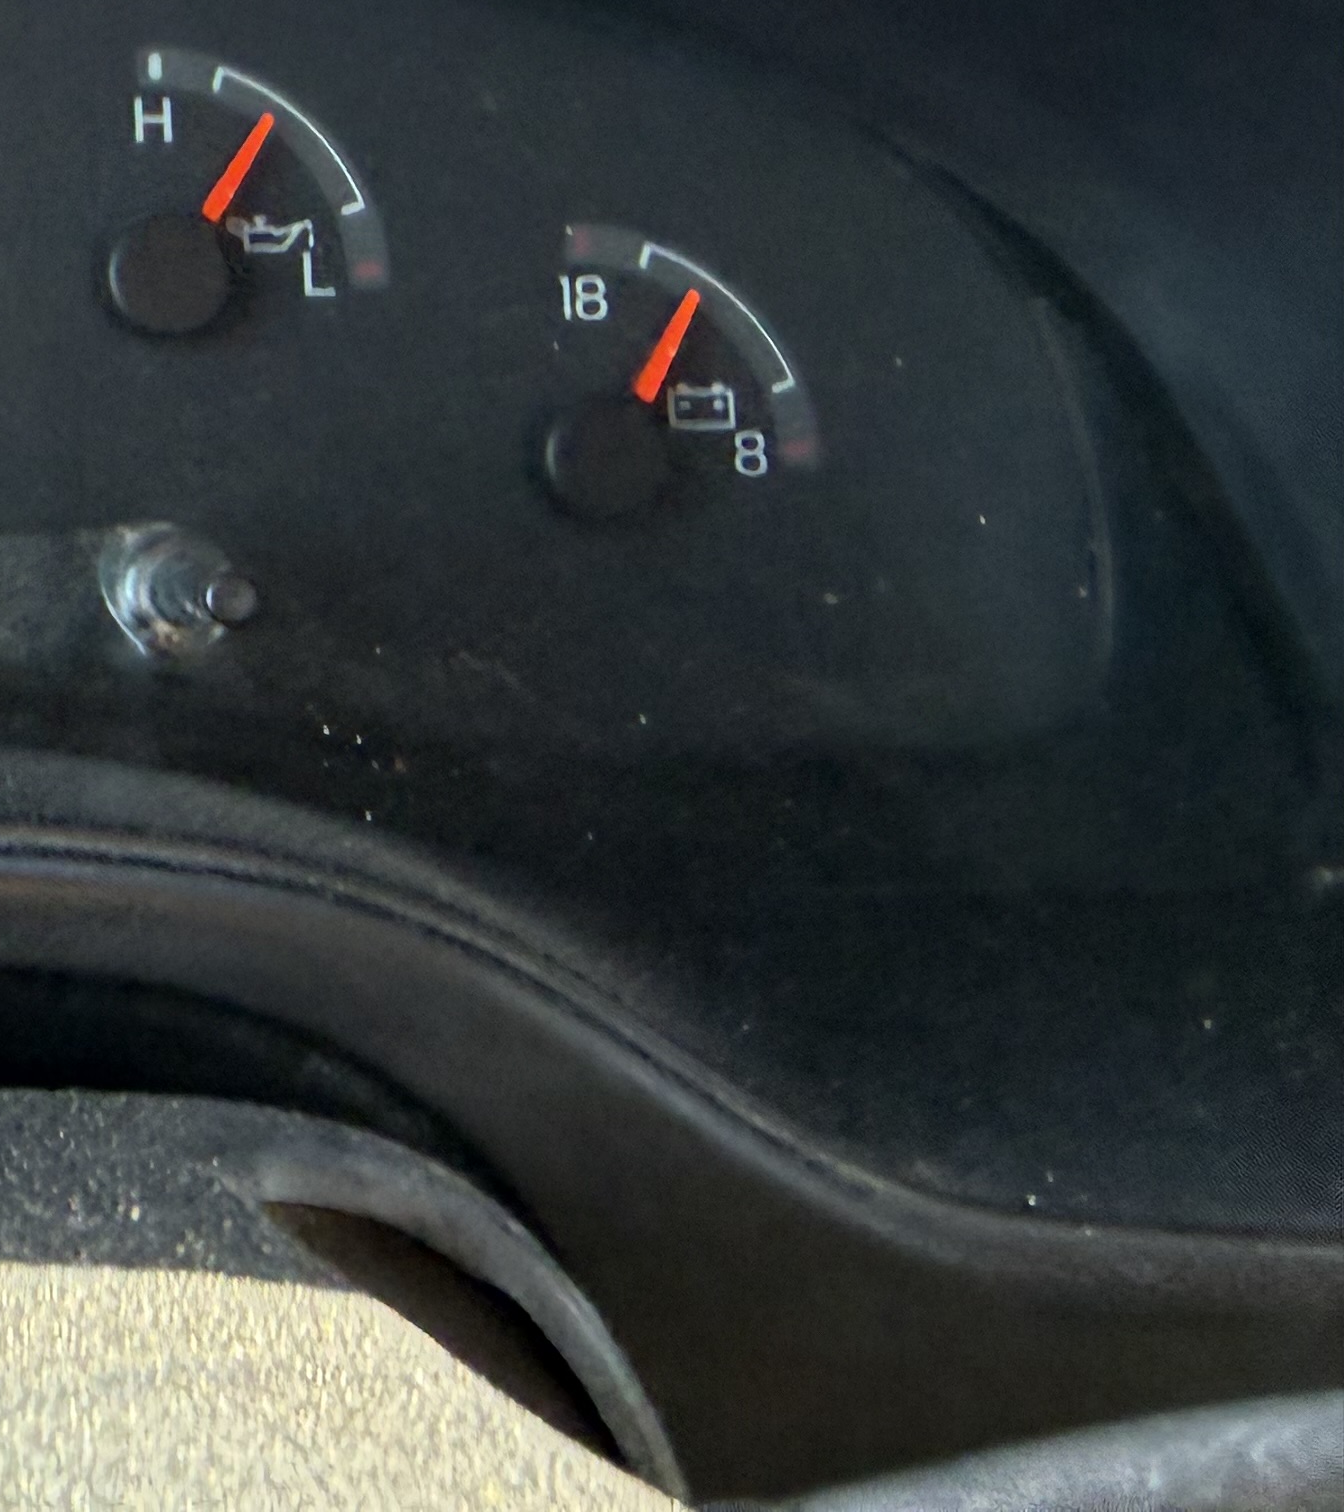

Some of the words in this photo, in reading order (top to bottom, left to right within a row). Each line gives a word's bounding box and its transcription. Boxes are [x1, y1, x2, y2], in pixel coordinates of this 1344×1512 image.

[134, 96, 173, 143] H
[302, 250, 336, 297] L
[559, 274, 608, 321] 18
[734, 429, 768, 477] 8
